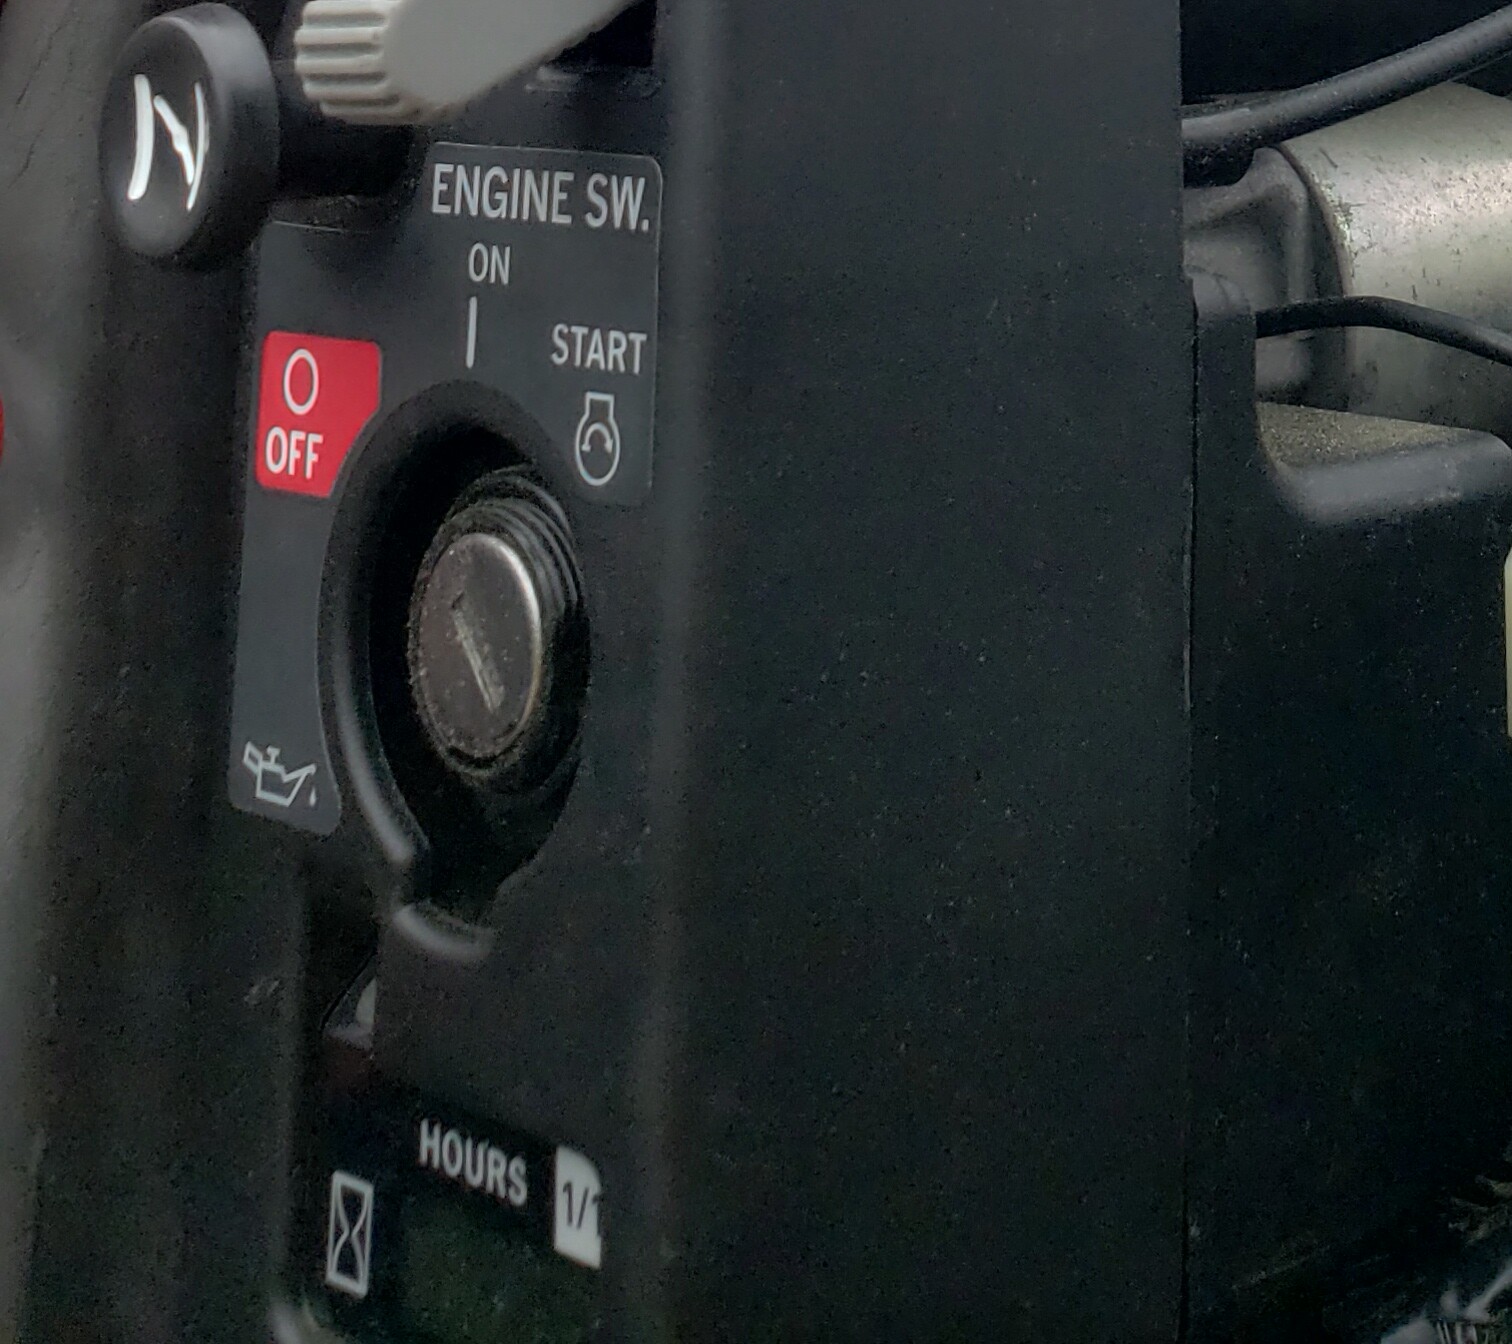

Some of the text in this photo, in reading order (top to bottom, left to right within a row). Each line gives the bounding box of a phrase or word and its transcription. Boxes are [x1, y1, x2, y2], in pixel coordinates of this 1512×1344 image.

[431, 162, 650, 233] ENGINE SW.
[467, 242, 511, 286] ON
[550, 322, 648, 376] START
[265, 425, 324, 480] OFF
[418, 1117, 529, 1207] HOURS
